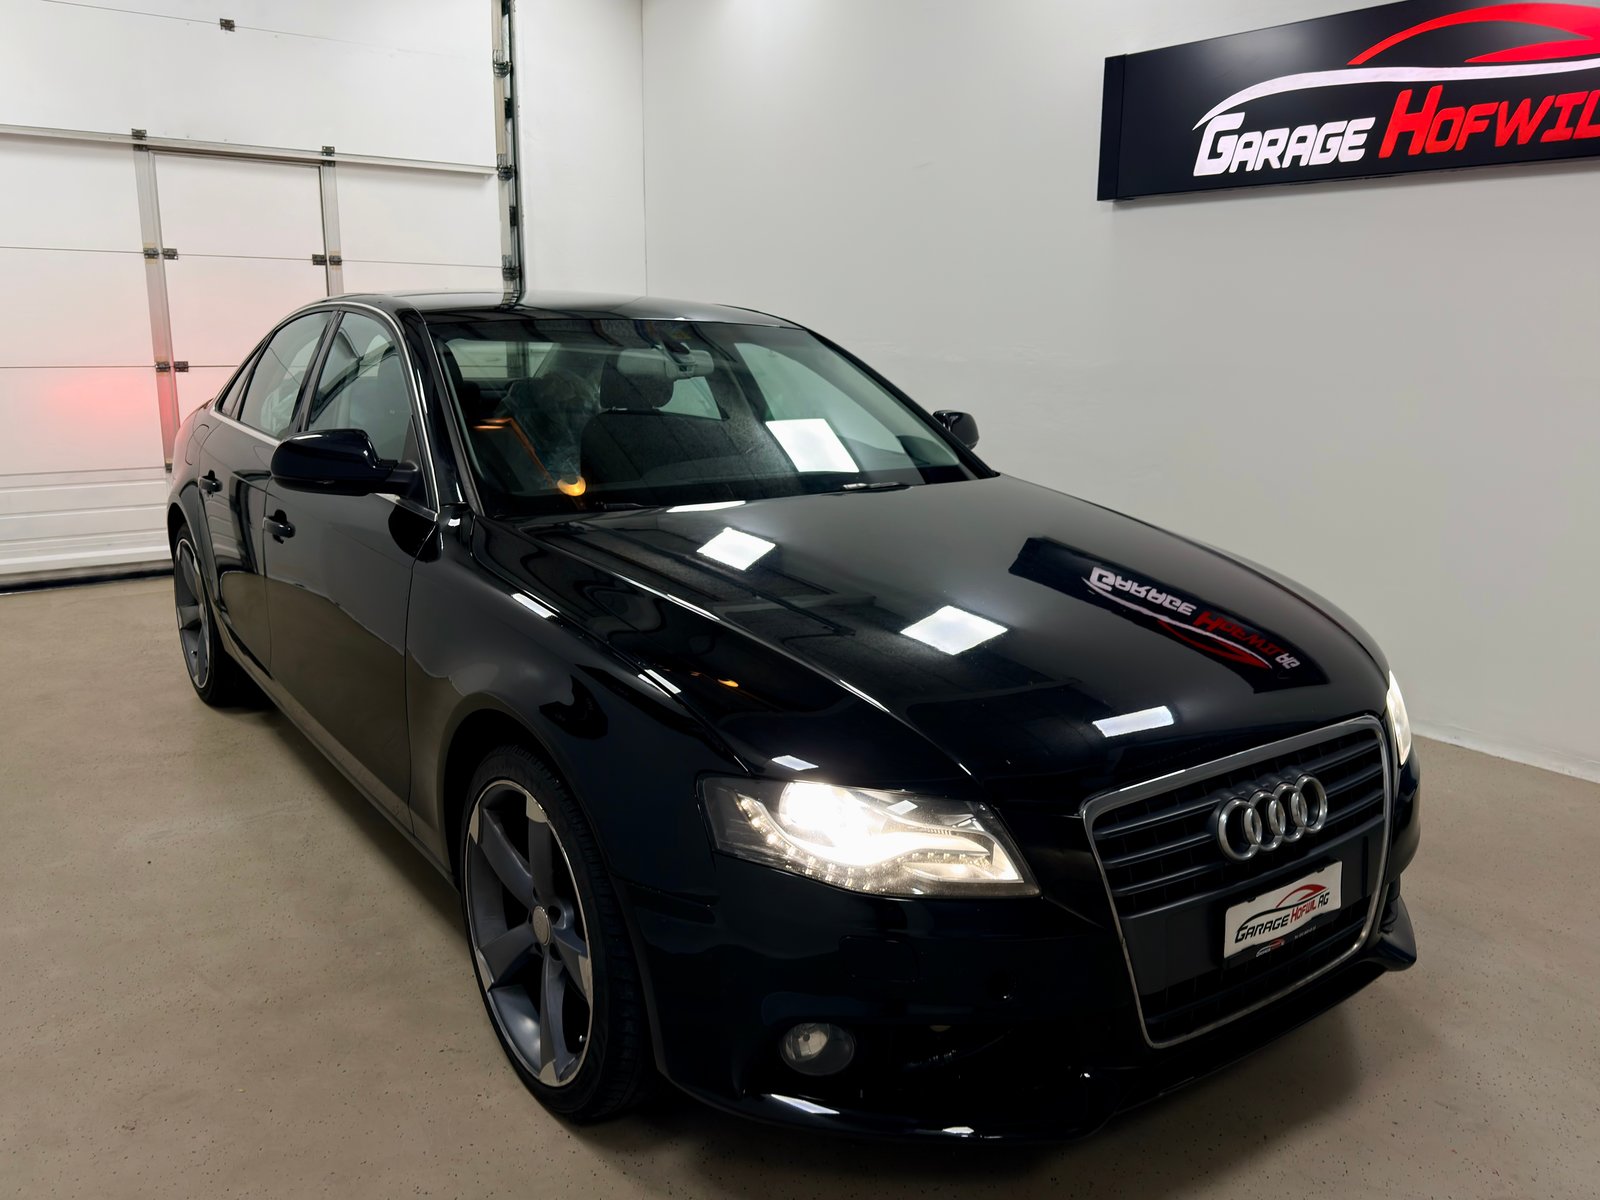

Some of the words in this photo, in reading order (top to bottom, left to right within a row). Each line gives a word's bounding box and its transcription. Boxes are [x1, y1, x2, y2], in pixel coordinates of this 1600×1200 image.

[1193, 112, 1376, 177] GARAGE
[1378, 84, 1600, 159] HOFWIL
[1234, 913, 1290, 943] GARAGE
[1290, 900, 1317, 923] HOFWIL
[1317, 892, 1330, 908] AG
